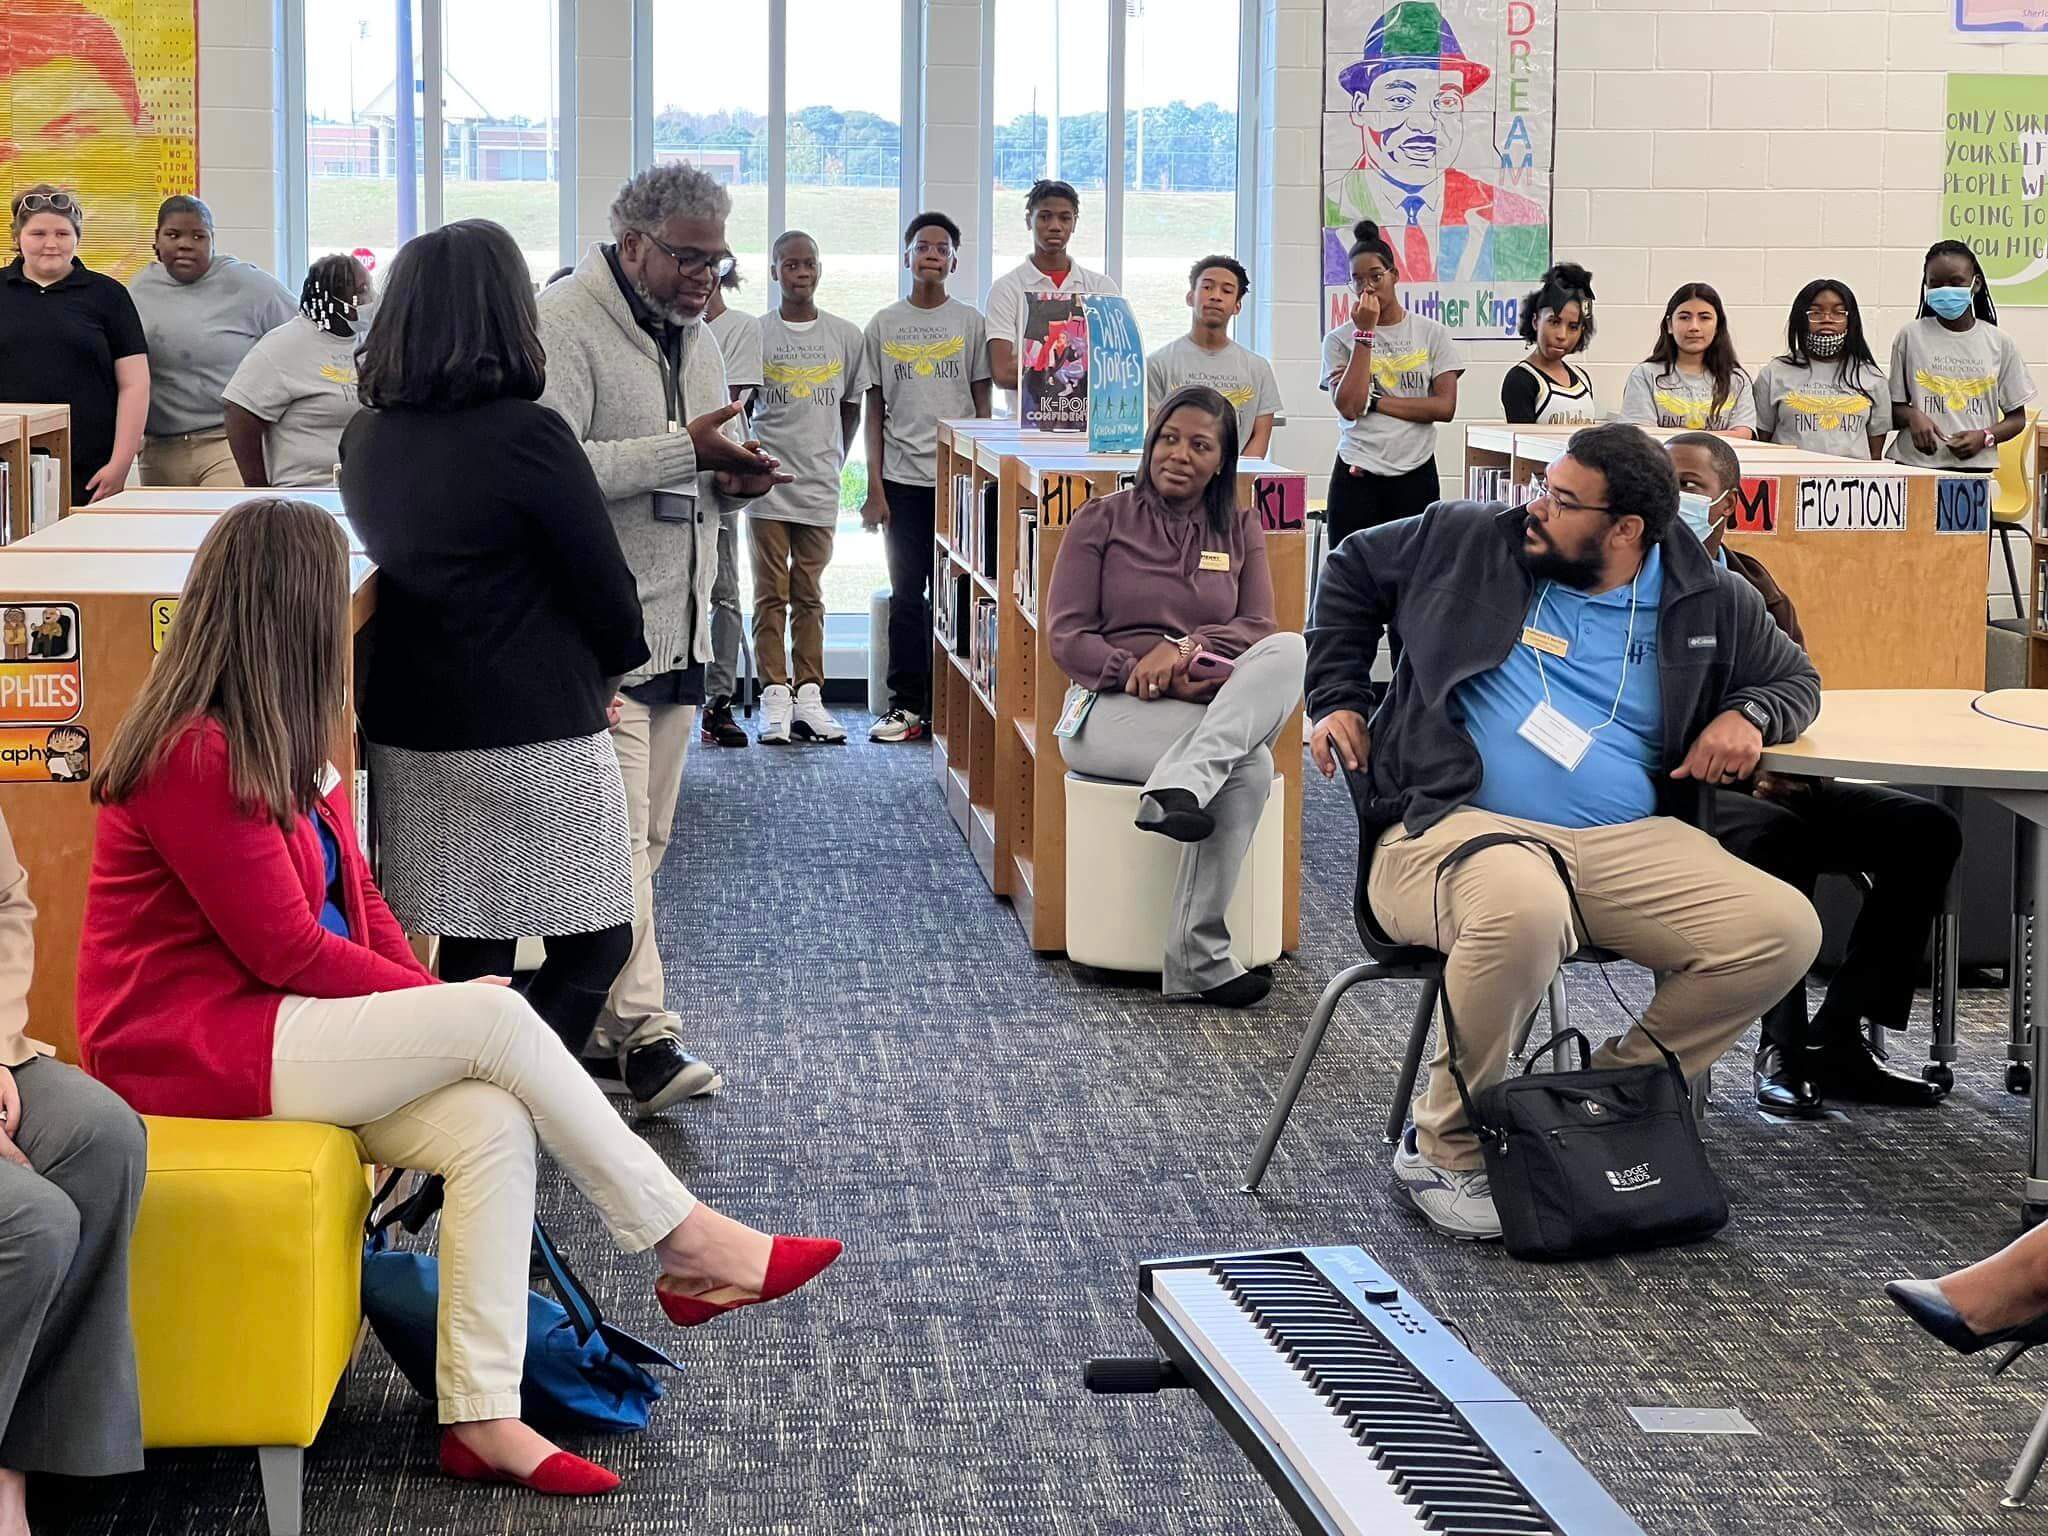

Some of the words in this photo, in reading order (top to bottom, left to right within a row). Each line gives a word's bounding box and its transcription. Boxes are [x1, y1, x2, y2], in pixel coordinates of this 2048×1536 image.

[1501, 1, 1534, 187] DREAM
[1946, 109, 1996, 135] ONLY
[1943, 171, 2013, 196] PEOPLE
[1950, 204, 2014, 228] GOING
[2023, 204, 2046, 228] TO
[1961, 234, 1999, 257] YOU
[2006, 235, 2048, 259] HIG
[1476, 289, 1518, 336] King
[1099, 303, 1131, 355] WAR
[893, 362, 913, 380] FINE
[934, 360, 960, 378] ARTS
[1094, 347, 1141, 390] STORIES
[811, 387, 835, 406] ARTS
[1924, 395, 1945, 414] FINE
[1795, 414, 1818, 432] FINE
[1801, 478, 1901, 527] FICTION
[1937, 479, 1986, 531] NOP
